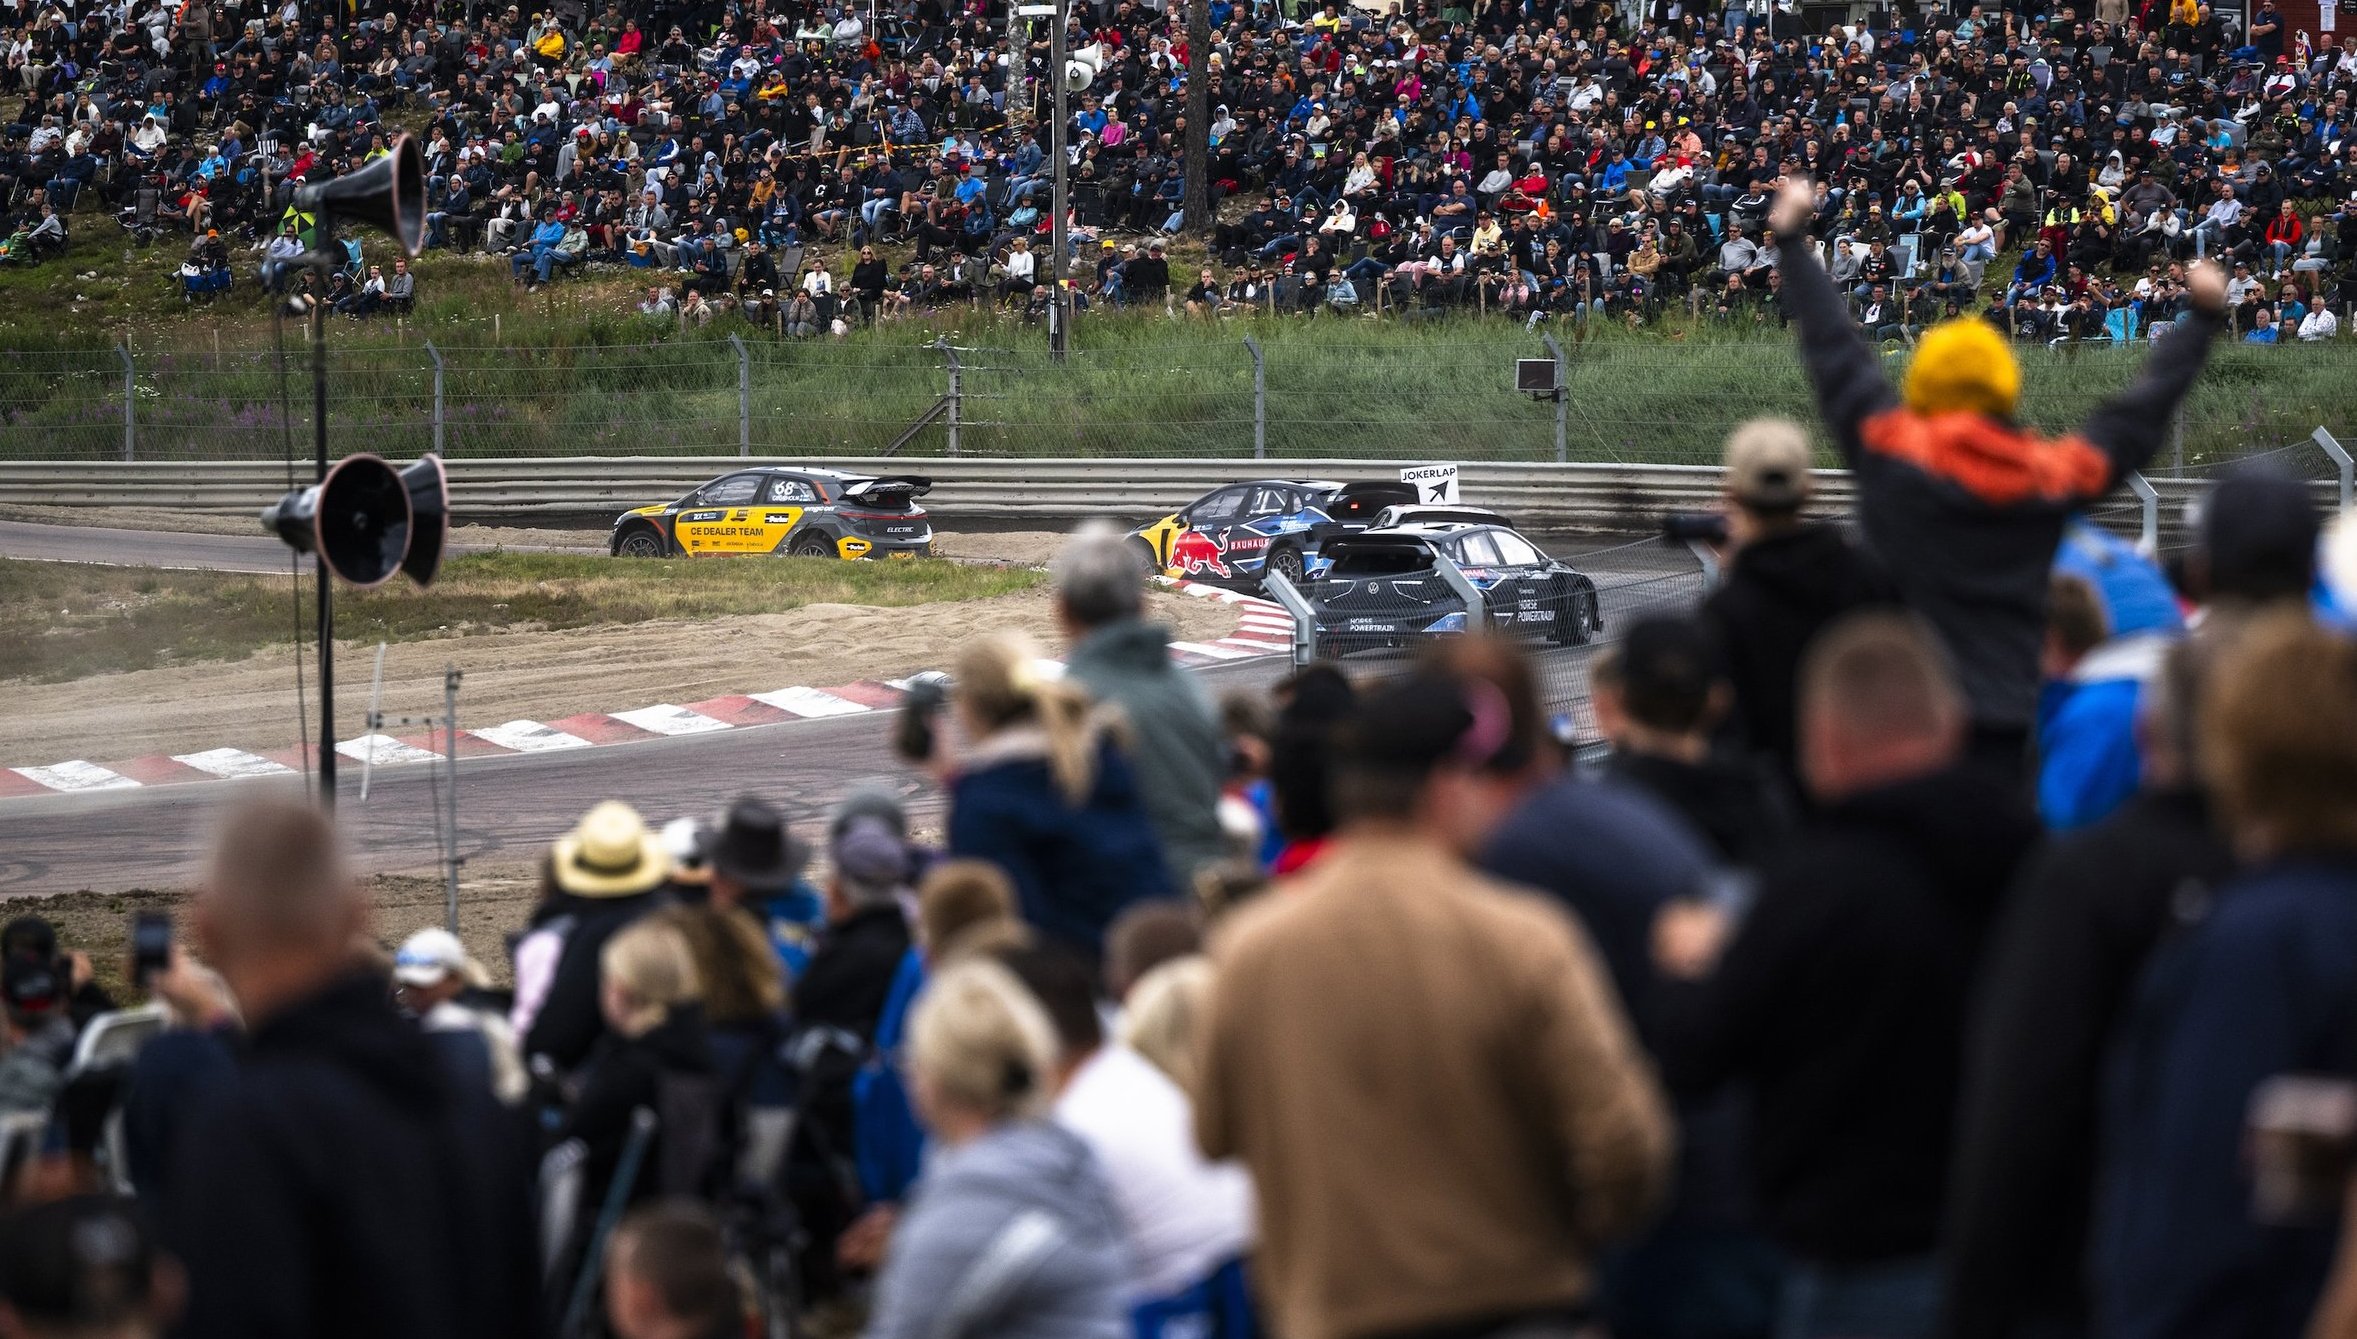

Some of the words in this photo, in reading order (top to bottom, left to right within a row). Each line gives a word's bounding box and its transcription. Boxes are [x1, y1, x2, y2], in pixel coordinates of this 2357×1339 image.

[1403, 468, 1456, 481] JOKERLAP
[774, 481, 795, 495] 68
[691, 527, 702, 536] CE
[703, 527, 737, 536] DEALER
[739, 527, 764, 536] TEAM
[1230, 538, 1270, 550] BAUHAUS
[1350, 624, 1395, 632] POWERTRAIN
